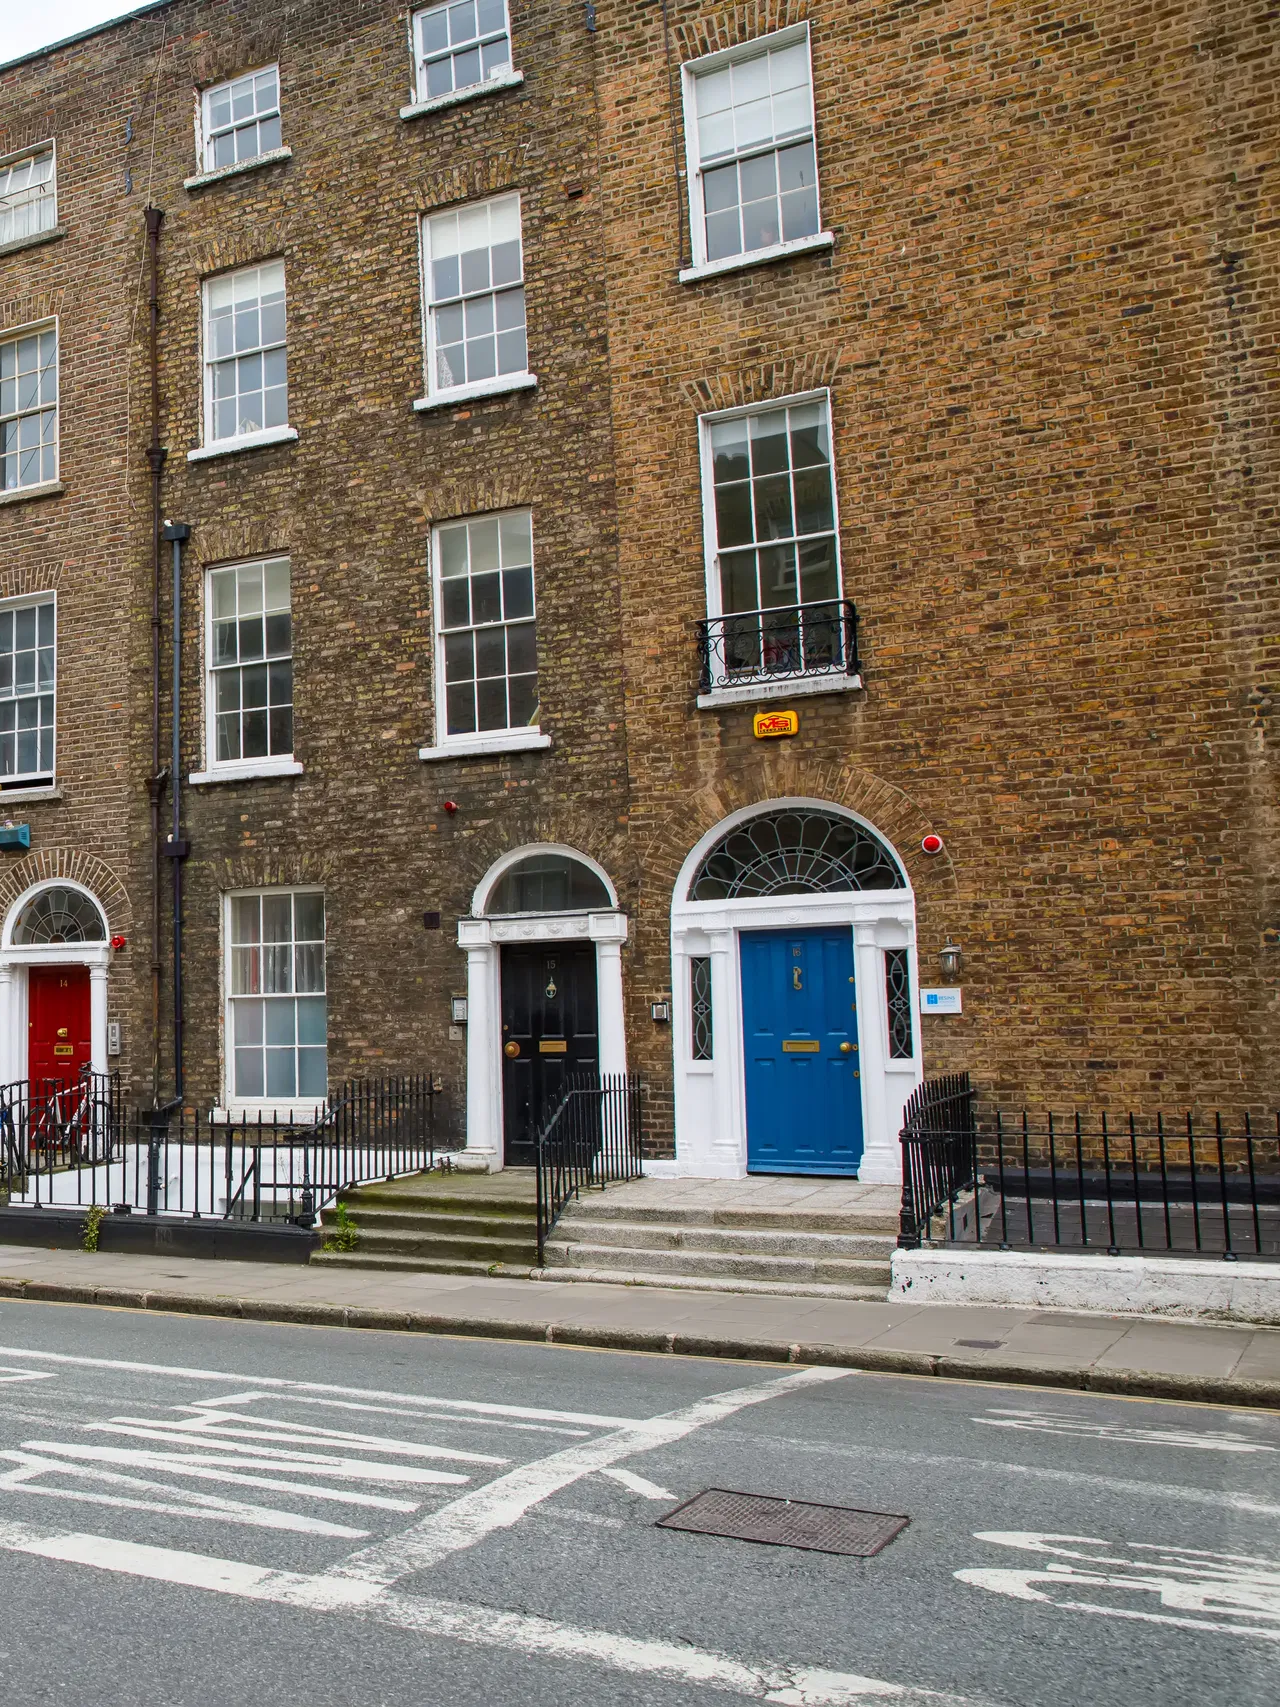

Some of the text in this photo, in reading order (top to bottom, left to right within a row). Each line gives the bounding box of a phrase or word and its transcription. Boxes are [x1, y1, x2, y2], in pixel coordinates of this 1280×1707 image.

[760, 717, 789, 729] MTS
[547, 960, 556, 969] 15
[60, 979, 68, 988] 14
